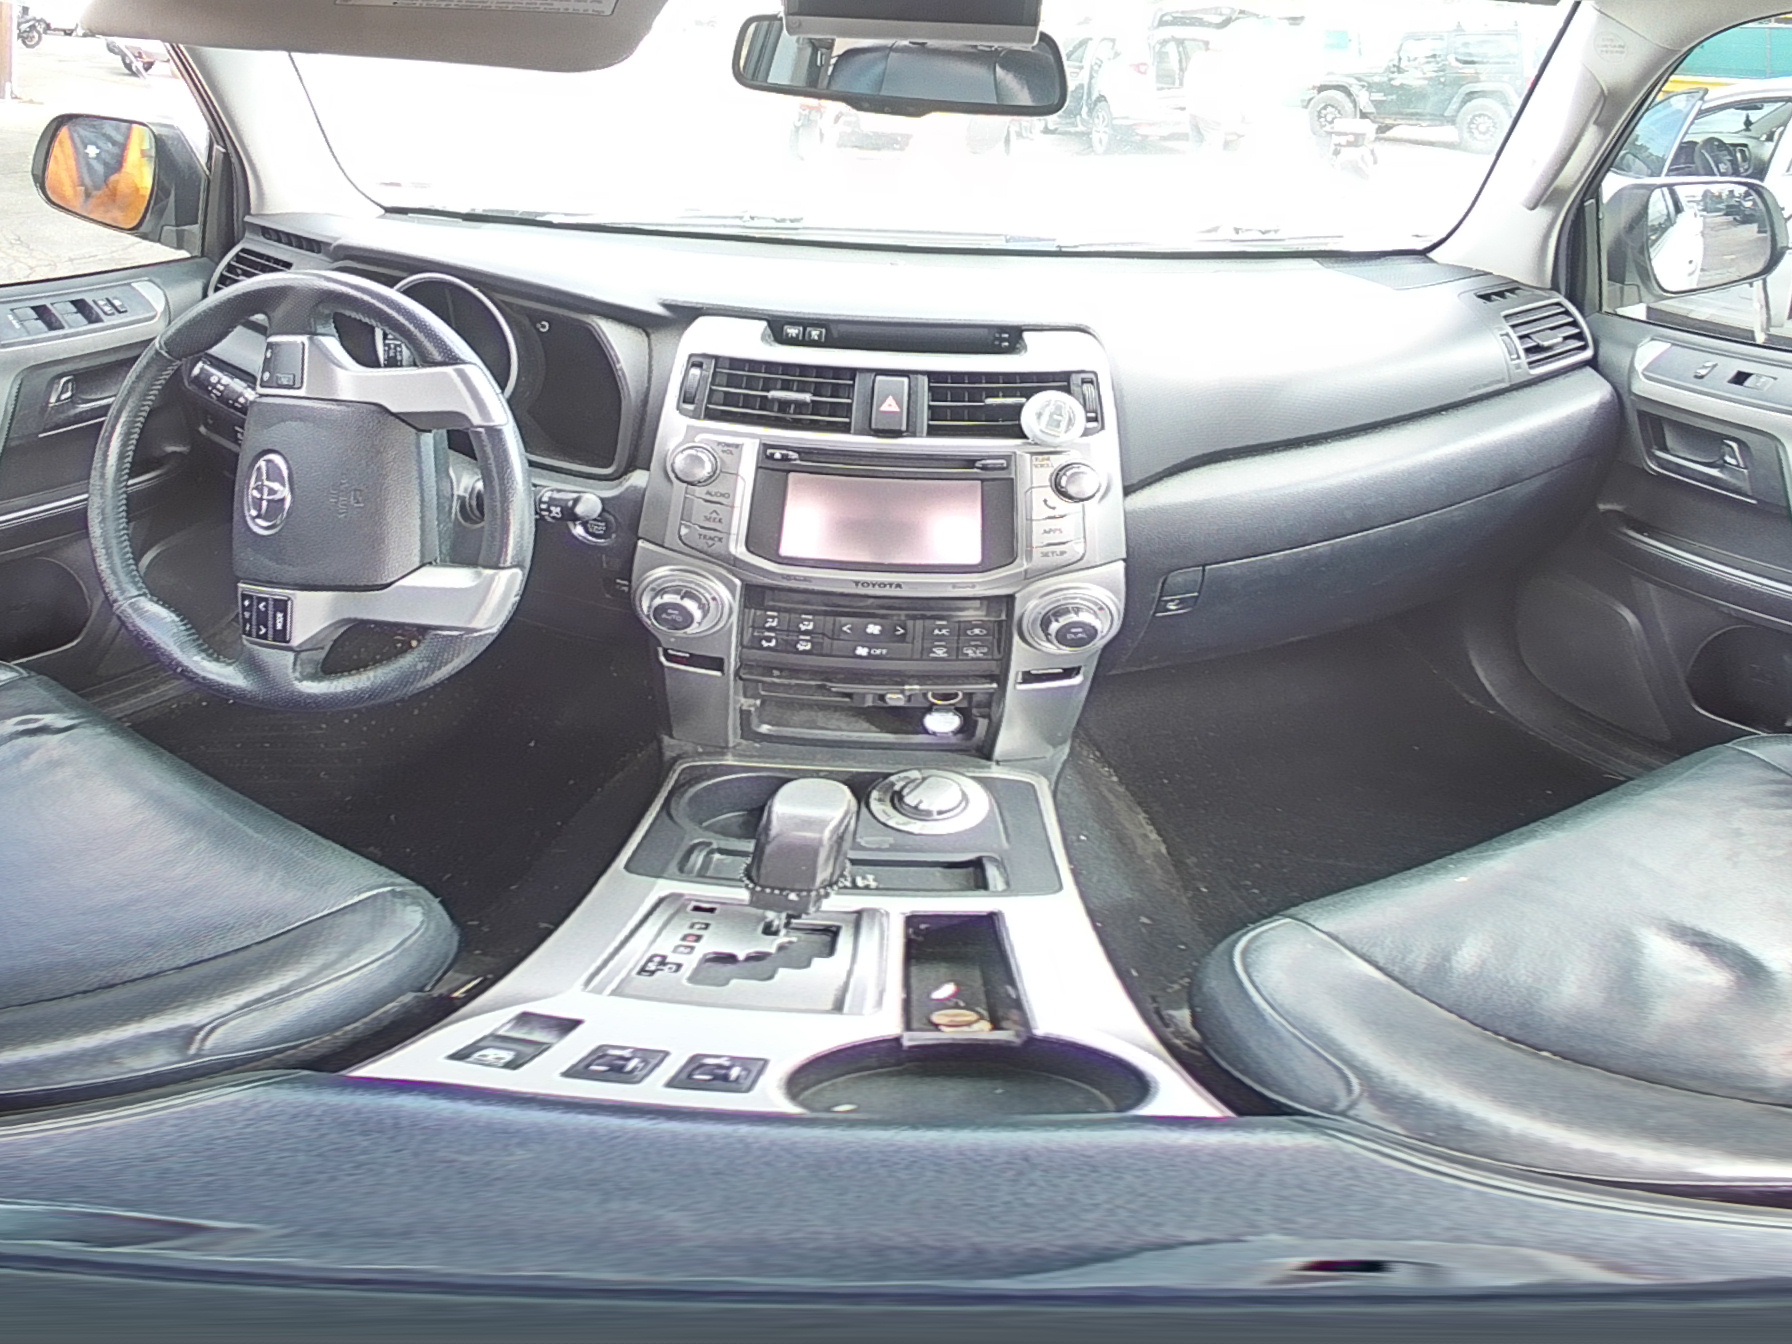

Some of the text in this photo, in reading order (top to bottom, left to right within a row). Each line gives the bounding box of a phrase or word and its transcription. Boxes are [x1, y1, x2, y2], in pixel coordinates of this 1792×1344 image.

[705, 490, 731, 500] AUDIO
[703, 515, 724, 524] SEEK
[1042, 527, 1063, 535] APPS
[698, 533, 724, 543] TRACK
[1040, 550, 1068, 558] SETUP
[853, 580, 904, 590] TOYOTA
[871, 648, 889, 656] OFF
